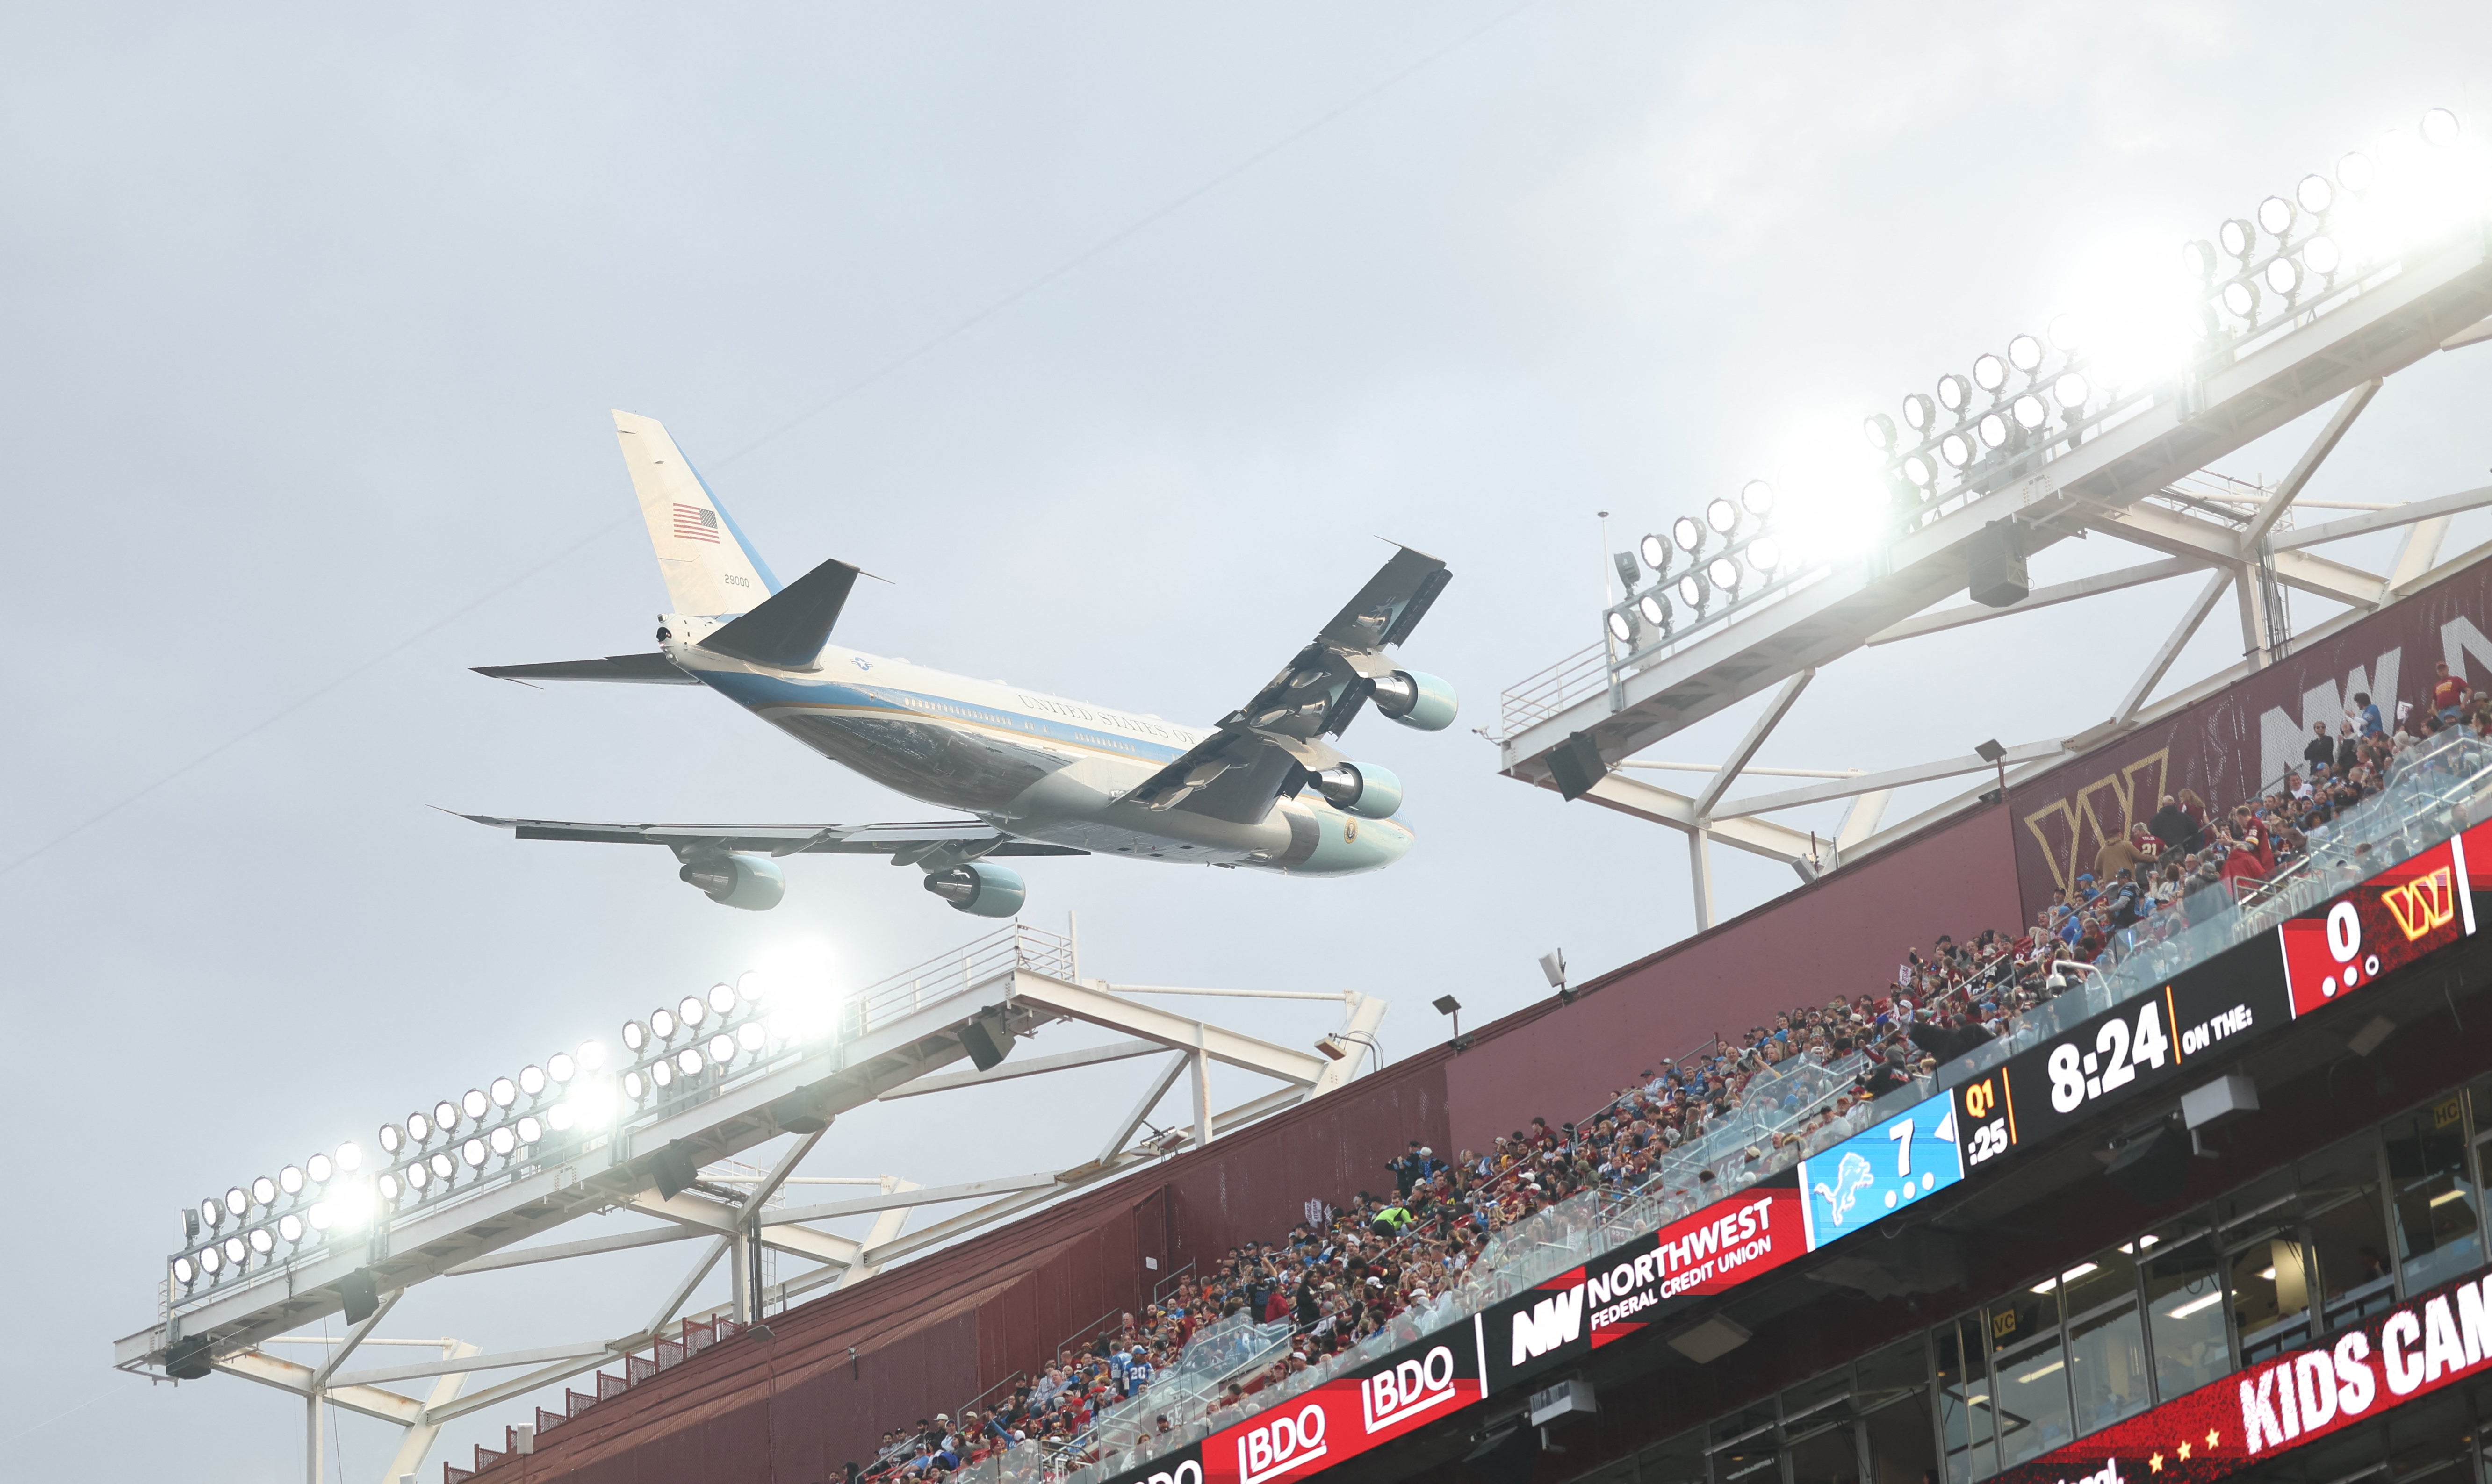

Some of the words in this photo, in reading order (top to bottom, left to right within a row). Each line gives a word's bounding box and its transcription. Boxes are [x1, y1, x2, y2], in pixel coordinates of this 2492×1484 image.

[724, 574, 749, 588] 29000
[1016, 694, 1093, 721] UNITED
[1097, 711, 1169, 738] STATES
[1173, 729, 1197, 745] OF
[2141, 843, 2157, 856] 21
[2326, 900, 2361, 963] 0
[2048, 1000, 2168, 1113] 8:24
[2182, 1022, 2210, 1055] ON
[2211, 1004, 2253, 1041] THE:
[1966, 1078, 1995, 1118] Q1
[2436, 1103, 2457, 1124] HC
[1889, 1118, 1915, 1177] 7
[1968, 1117, 2008, 1166] :25
[1587, 1196, 1772, 1309] NORTHWEST
[1590, 1289, 1658, 1331] FEDERAL
[1660, 1261, 1715, 1299] CREDIT
[1717, 1235, 1772, 1273] UNION
[1512, 1283, 1585, 1367] NW
[1994, 1314, 2014, 1333] VC
[1130, 1367, 1146, 1380] 20
[1372, 1346, 1454, 1417] BDO
[2240, 1331, 2376, 1456] KIDS
[1248, 1404, 1326, 1473] BDO
